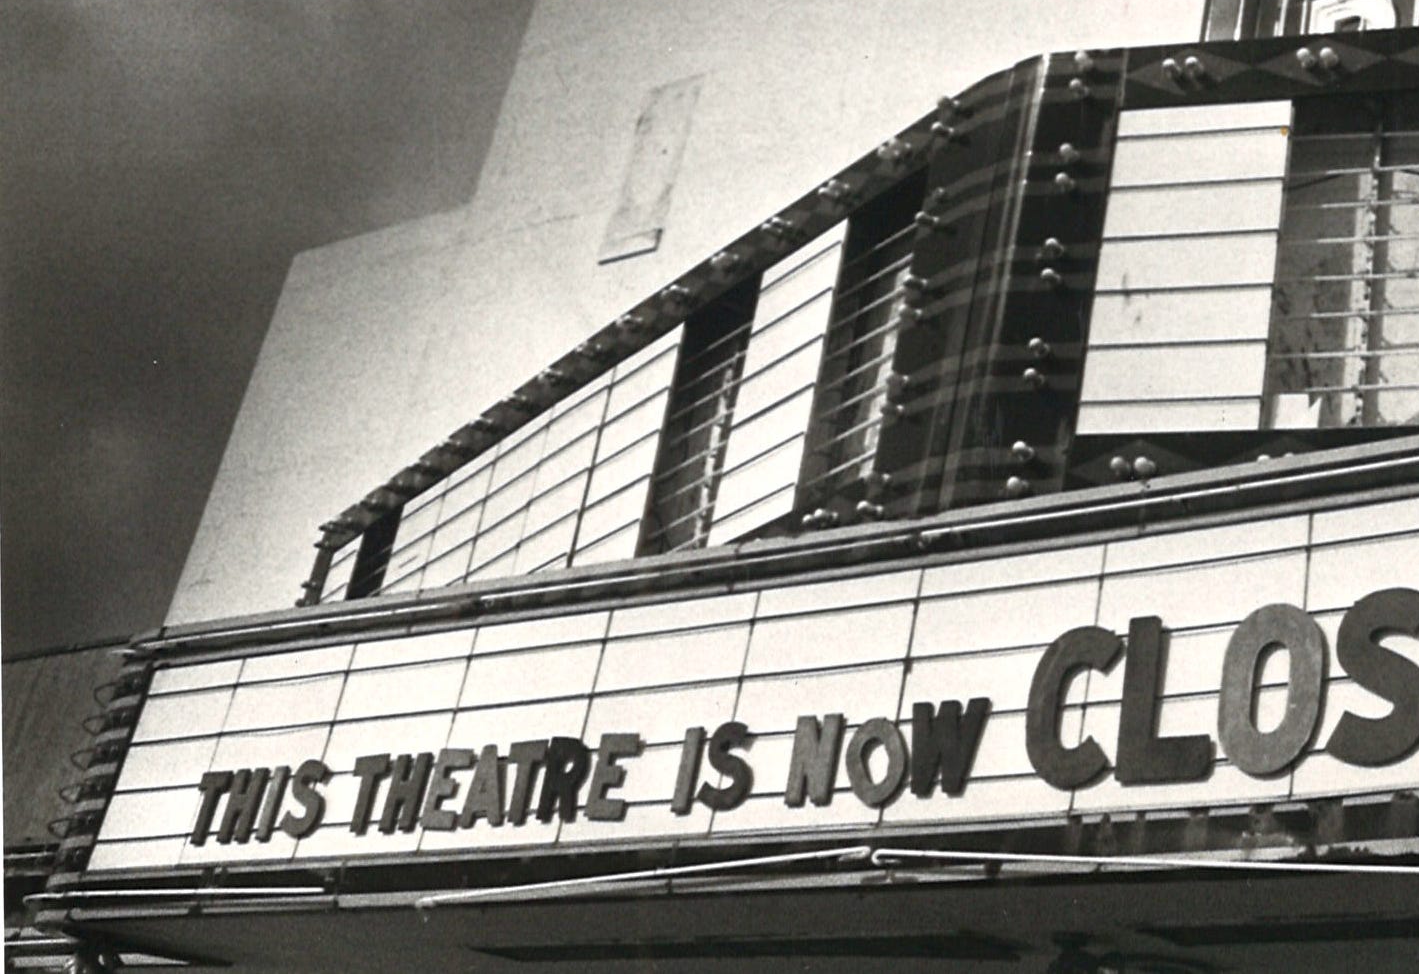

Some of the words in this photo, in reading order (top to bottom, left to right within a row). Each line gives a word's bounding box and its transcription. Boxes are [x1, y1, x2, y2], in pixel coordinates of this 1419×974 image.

[189, 758, 328, 846] THIS
[349, 732, 646, 837] THEATRE
[670, 721, 756, 816] IS
[784, 696, 992, 809] NOW
